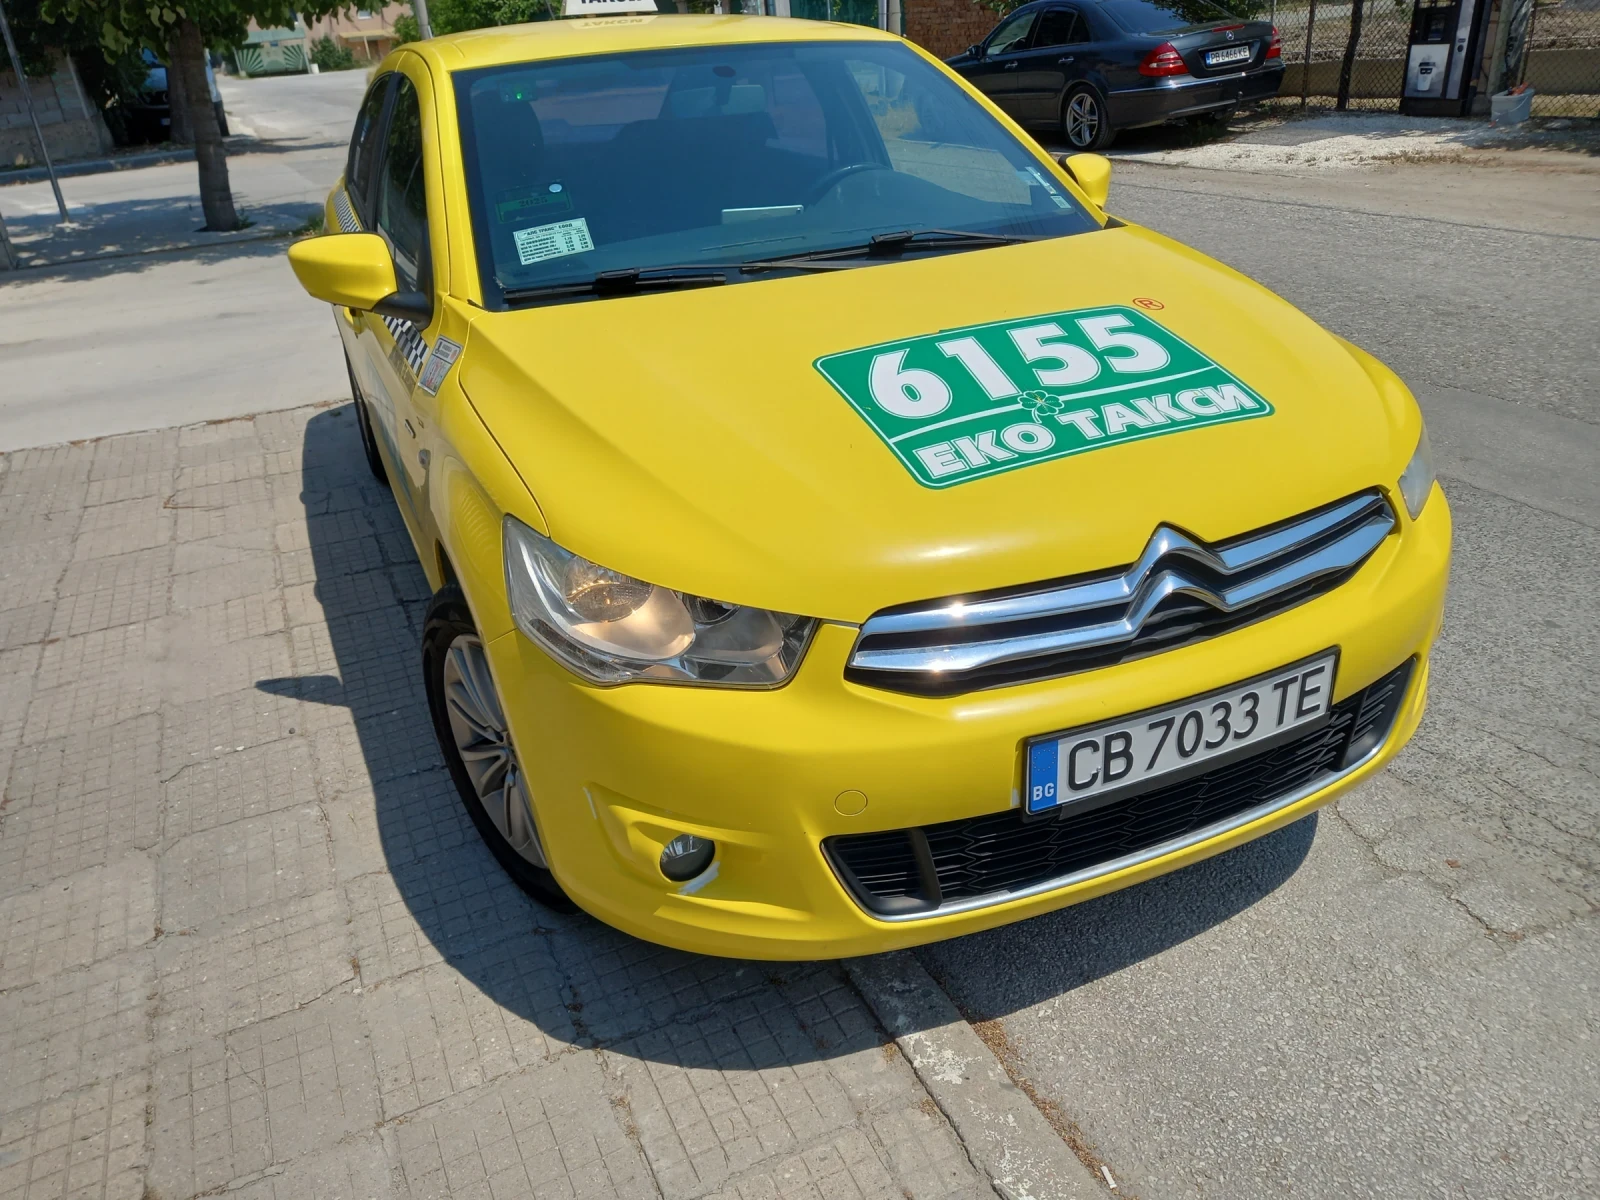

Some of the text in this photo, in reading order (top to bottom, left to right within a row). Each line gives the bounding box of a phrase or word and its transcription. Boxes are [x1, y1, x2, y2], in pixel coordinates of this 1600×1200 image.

[868, 313, 1171, 419] 6155
[914, 382, 1259, 479] ЕКО ТАКСИ
[1067, 665, 1326, 791] CB 7033 TE
[1032, 783, 1055, 801] BG
